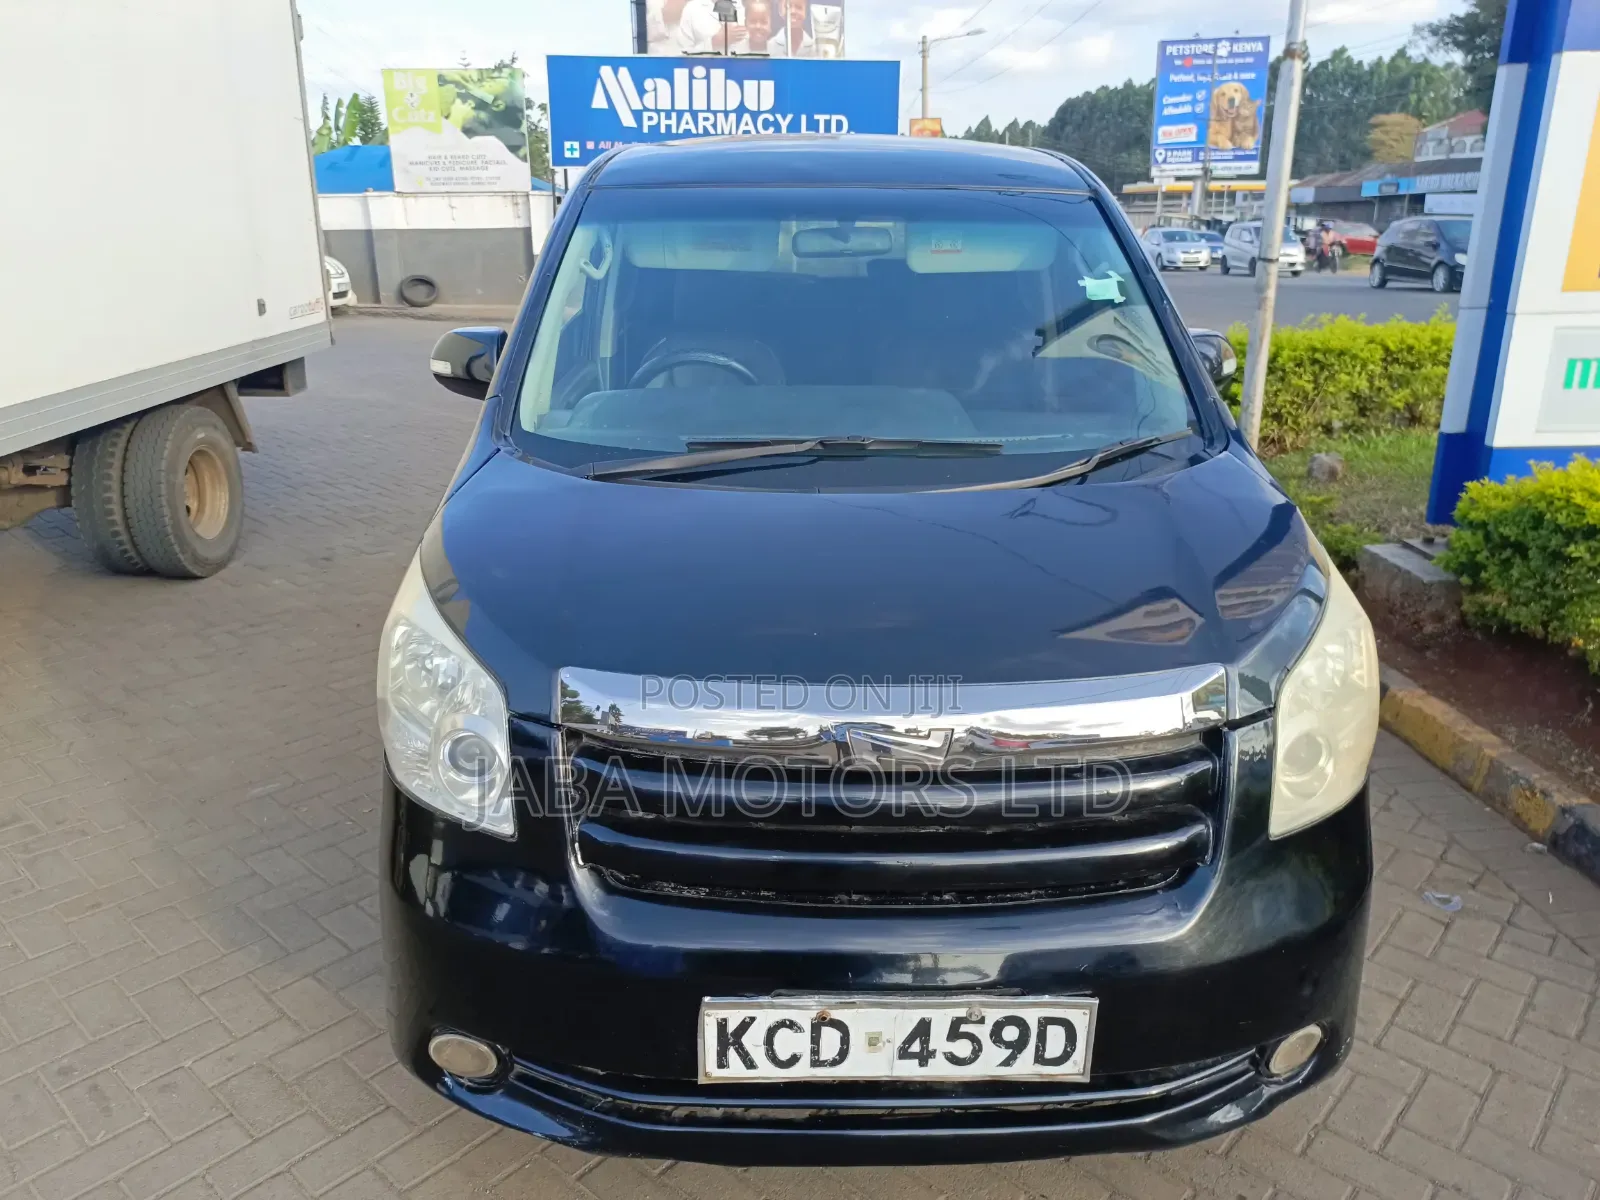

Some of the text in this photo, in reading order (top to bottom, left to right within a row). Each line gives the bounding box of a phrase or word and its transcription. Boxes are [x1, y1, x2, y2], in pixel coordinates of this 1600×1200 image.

[1166, 41, 1264, 56] PETSTORE KENYA
[591, 65, 774, 128] Malibu
[642, 112, 855, 135] PHARMACY LTD.
[598, 141, 612, 149] All
[715, 1014, 1079, 1070] KCD 459D
